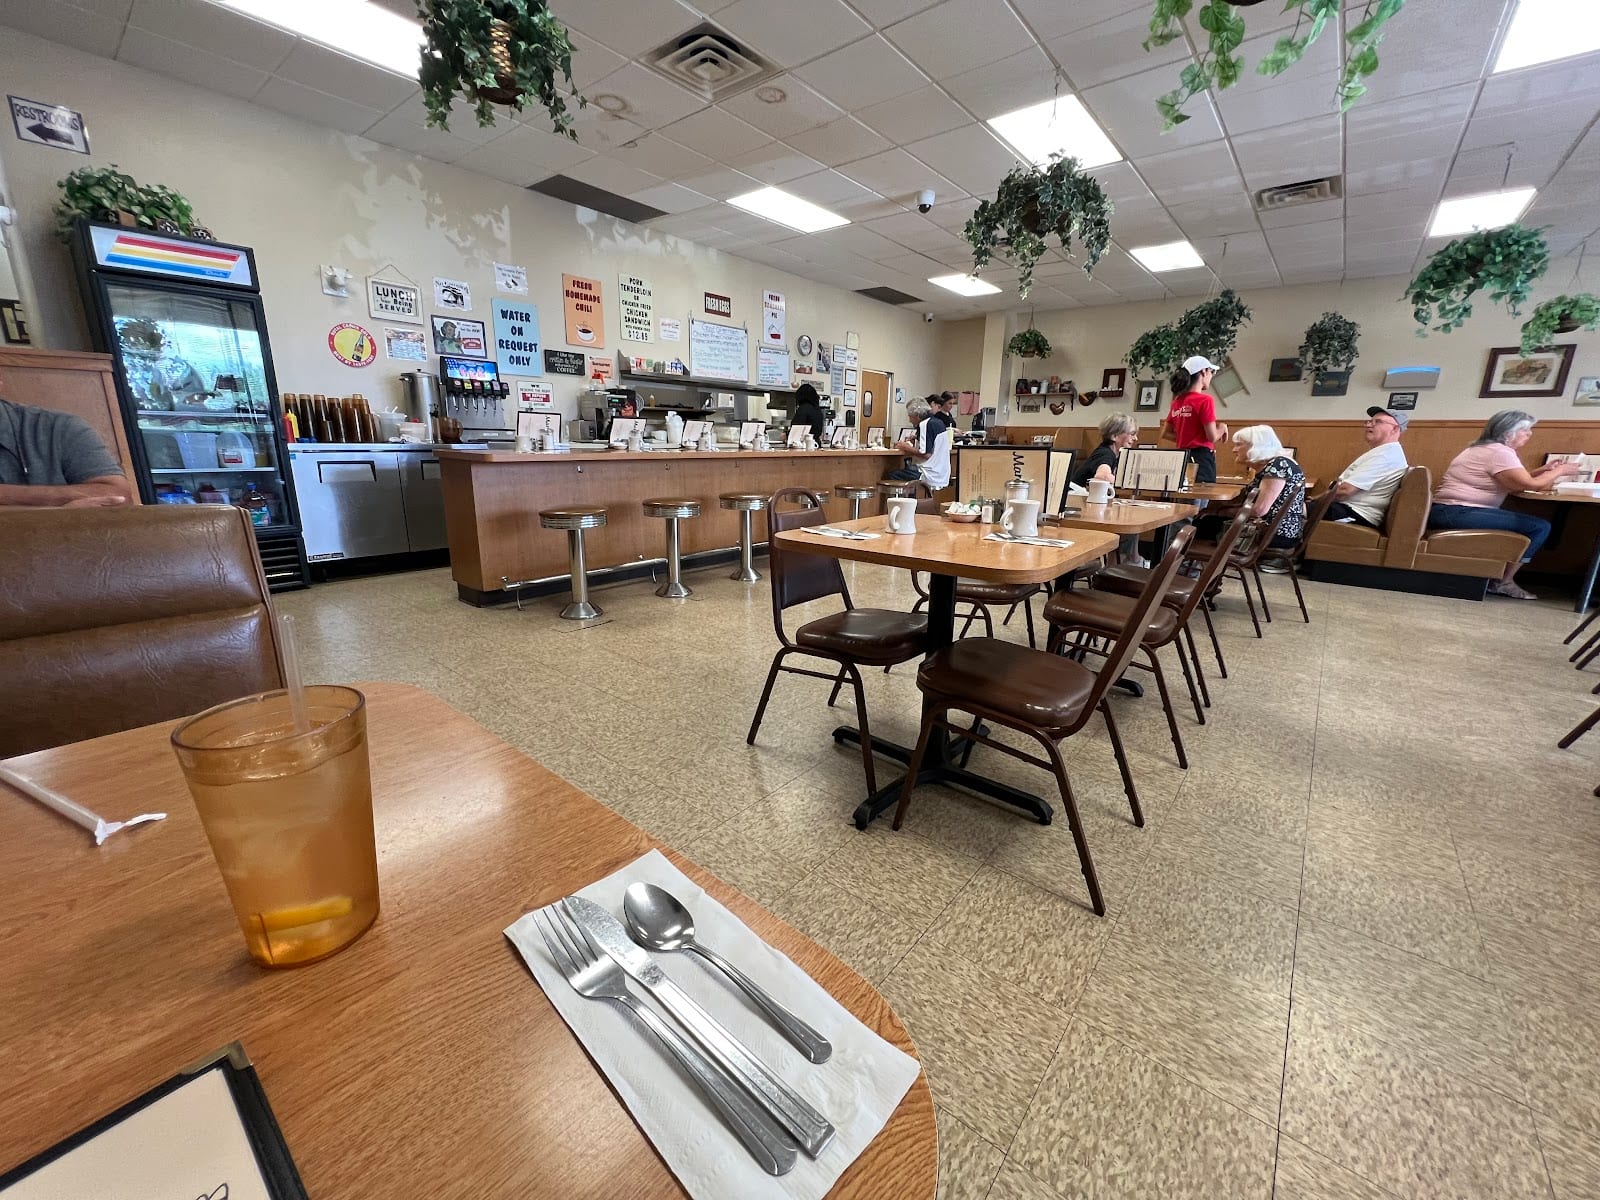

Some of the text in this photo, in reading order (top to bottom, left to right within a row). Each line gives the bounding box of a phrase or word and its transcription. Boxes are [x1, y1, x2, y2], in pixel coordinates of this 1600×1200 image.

[14, 104, 79, 131] RESTROOS
[376, 286, 413, 302] LUNCH
[565, 289, 601, 303] HOMEMADE
[379, 303, 412, 313] SERVED
[575, 303, 592, 313] CHILI
[501, 309, 531, 323] WATER
[510, 325, 524, 336] ON
[498, 338, 538, 352] REQUEST
[509, 354, 531, 366] ONLY
